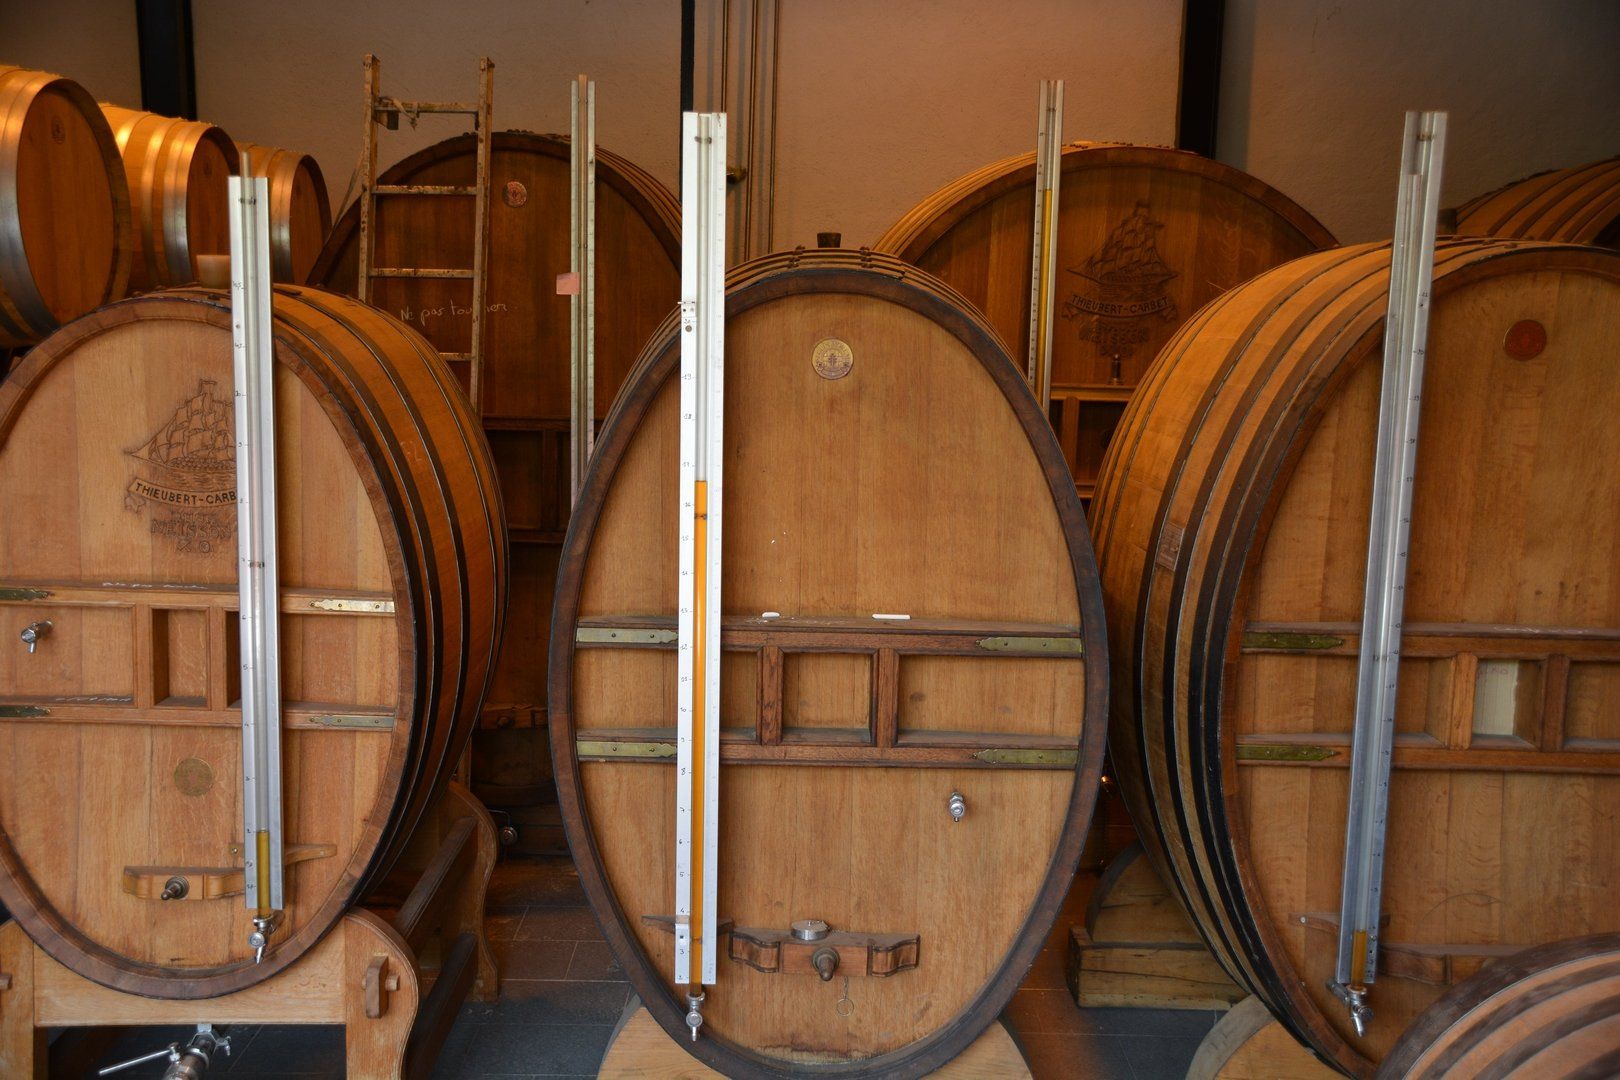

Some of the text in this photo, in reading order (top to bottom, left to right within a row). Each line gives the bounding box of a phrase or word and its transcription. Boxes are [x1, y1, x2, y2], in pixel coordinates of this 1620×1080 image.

[421, 308, 445, 327] pas
[450, 299, 508, 316] touer
[1072, 294, 1168, 315] THIEUBERT-CARBET
[135, 482, 237, 505] THIEUBERT-CARB
